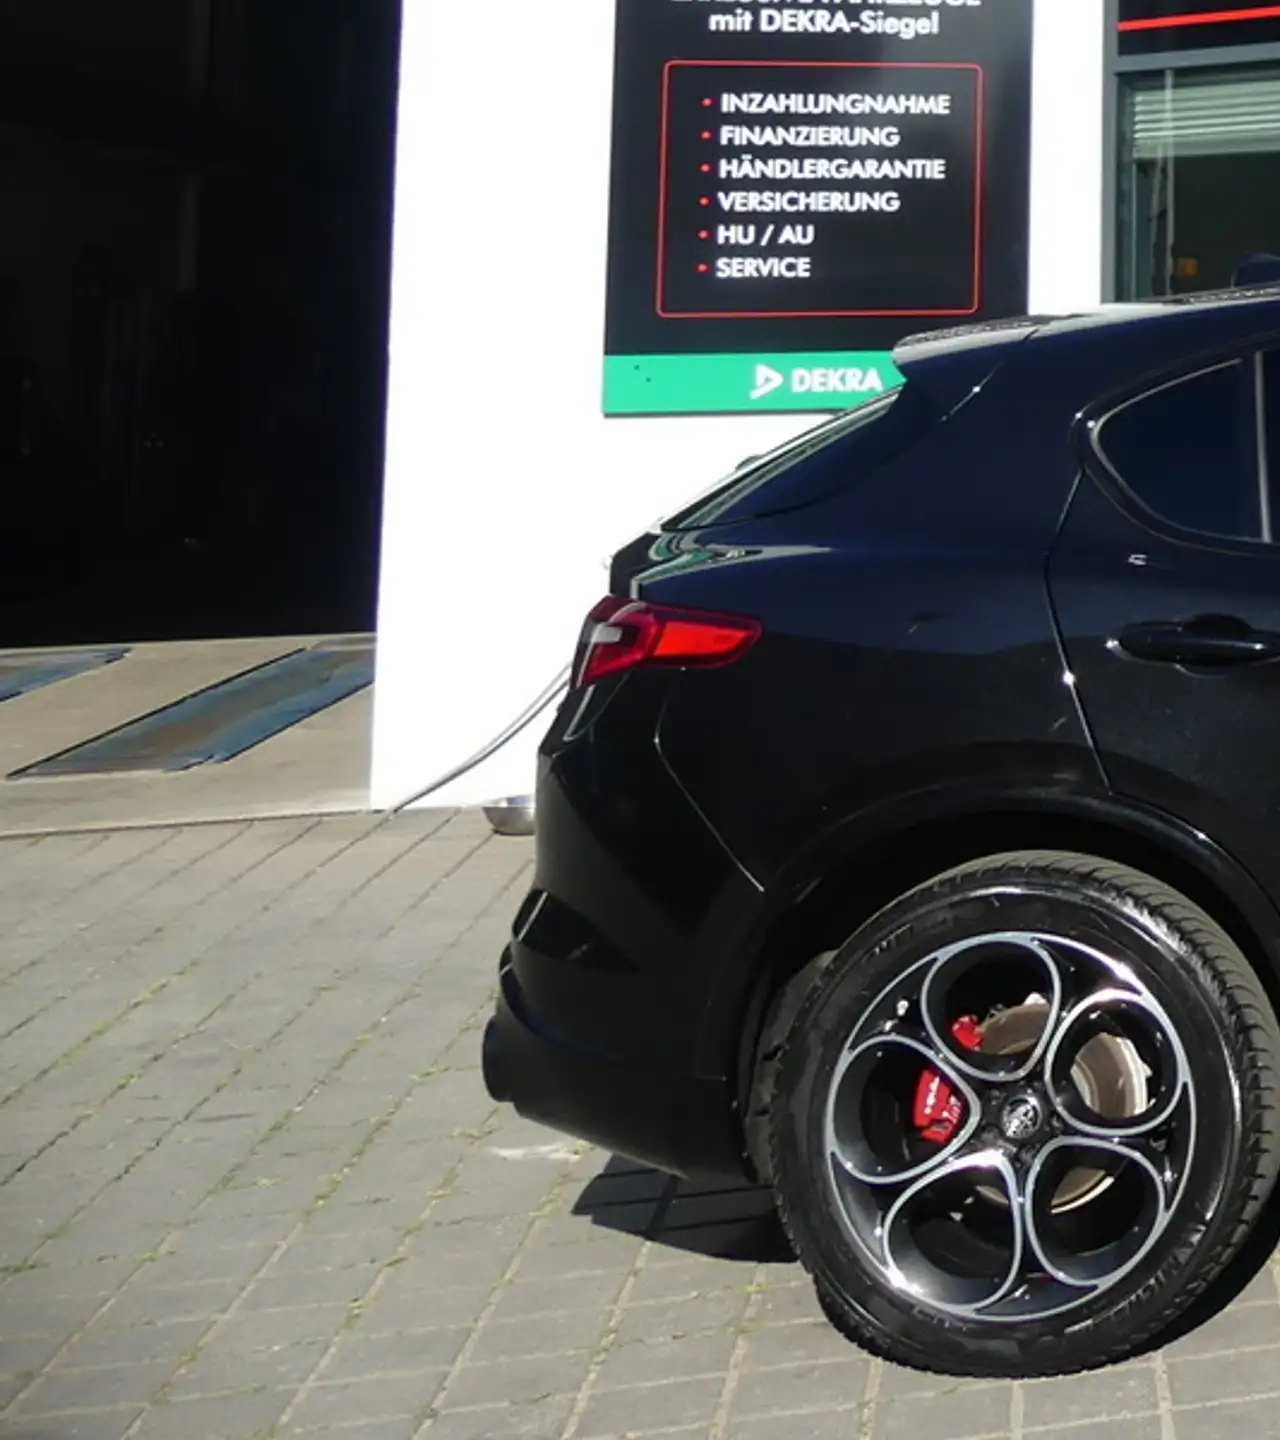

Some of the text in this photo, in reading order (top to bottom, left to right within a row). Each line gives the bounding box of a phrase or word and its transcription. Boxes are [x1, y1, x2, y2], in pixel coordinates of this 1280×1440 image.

[708, 8, 940, 40] mit DEKRA-Siegel
[721, 92, 952, 115] INZAHLUNGNAHME
[719, 125, 901, 148] FINANZIERUNG
[719, 154, 946, 180] HÄNDLERGARANTIE
[717, 190, 901, 213] VERSICHERUNG
[717, 223, 815, 247] HU / AU
[715, 256, 811, 279] SERVICE
[791, 368, 883, 393] DEKRA
